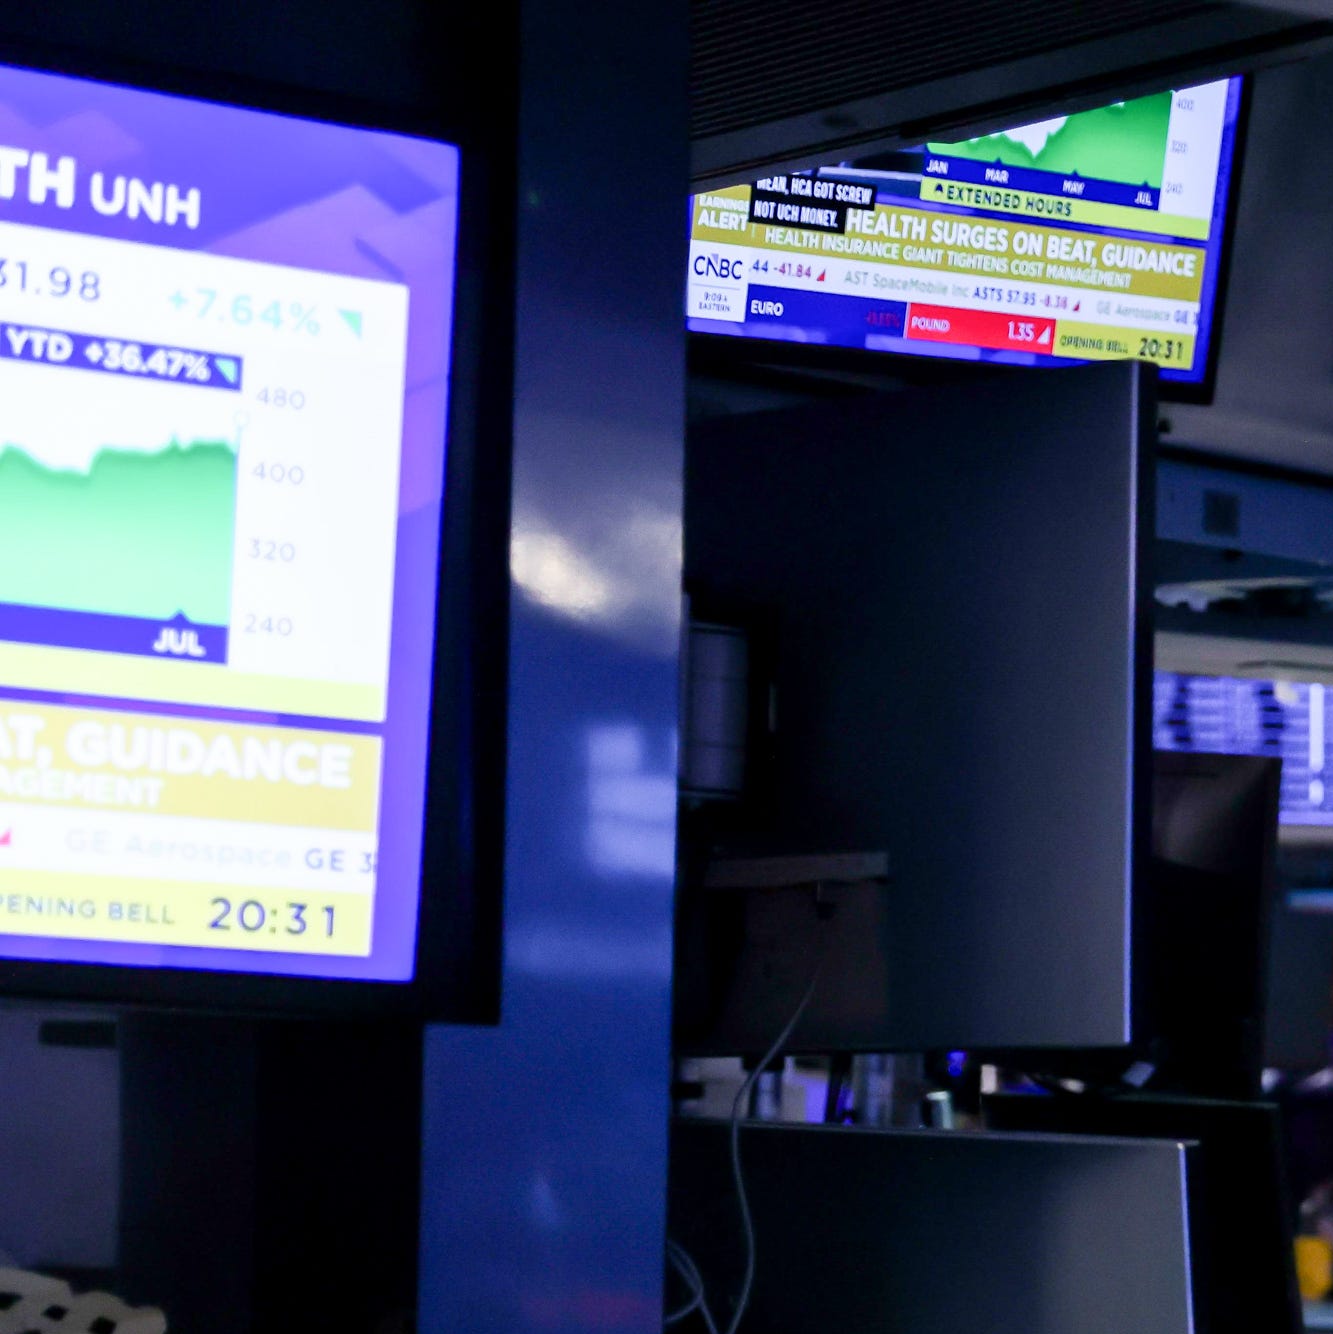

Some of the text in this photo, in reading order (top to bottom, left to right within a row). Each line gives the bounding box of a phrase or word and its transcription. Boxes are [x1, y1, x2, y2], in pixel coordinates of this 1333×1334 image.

[926, 158, 950, 176] JAN
[984, 167, 1010, 185] MAR
[90, 172, 201, 230] UNH
[791, 178, 813, 195] HCA
[814, 180, 835, 200] GOT
[836, 183, 874, 205] SCREW
[946, 184, 1073, 218] EXTENDED HOURS
[1062, 180, 1087, 197] MAY
[1133, 190, 1153, 207] JUL
[697, 207, 748, 232] ALERT
[753, 200, 839, 228] NOT UCH MONEY.
[846, 206, 928, 242] HEALTH
[930, 218, 1009, 255] SURGES
[1012, 230, 1044, 254] ON
[1045, 233, 1097, 268] BEAT,
[1101, 241, 1197, 278] GUIDANCE
[693, 254, 744, 280] CNBC
[764, 226, 1132, 289] HEALTH INSURANCE GIANT TIGHTENS COST MANAGEMENT
[773, 262, 812, 280] -41.84
[844, 270, 869, 286] AST
[872, 273, 949, 299] SpaceMobile
[972, 286, 1003, 304] ASTS
[167, 287, 321, 338] +7.64%
[698, 302, 731, 313] EASTERN
[750, 299, 785, 317] EURO
[910, 315, 950, 333] POUND
[5, 326, 213, 381] YTD +36.47%
[1060, 333, 1103, 351] OPENING
[1138, 337, 1184, 361] 20:31
[256, 387, 307, 411] 480
[251, 462, 305, 486] 400
[247, 537, 297, 563] 320
[243, 613, 294, 637] 240
[153, 627, 207, 657] JUL
[66, 719, 355, 789] GUIDANCE
[304, 847, 346, 872] GE
[0, 893, 336, 938] ENING BELL 20:31
